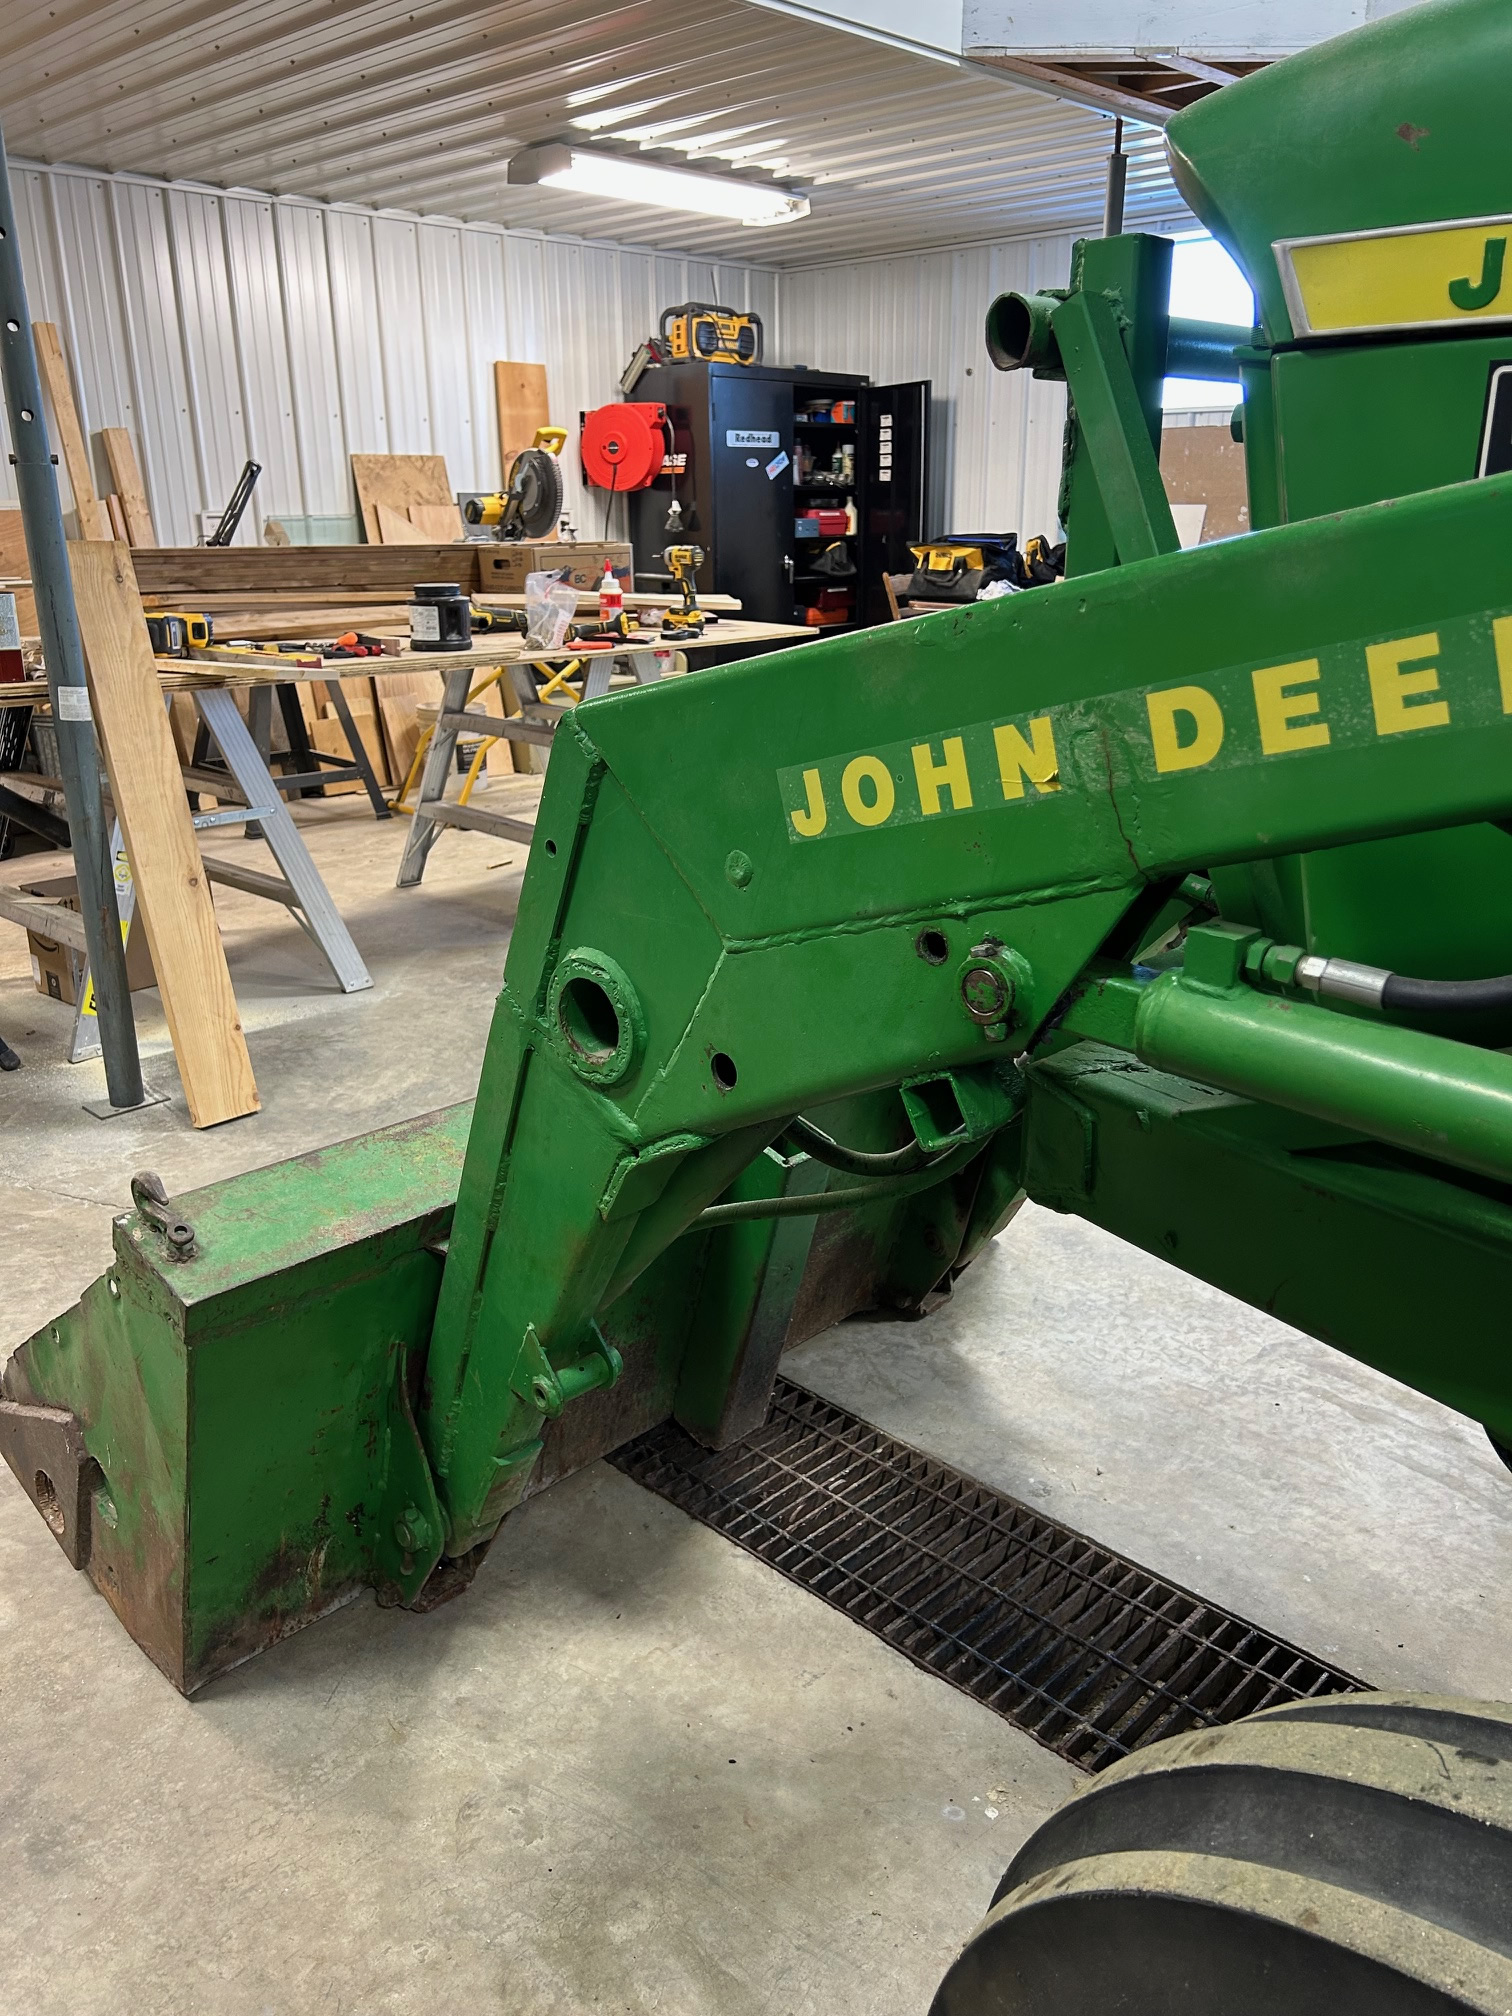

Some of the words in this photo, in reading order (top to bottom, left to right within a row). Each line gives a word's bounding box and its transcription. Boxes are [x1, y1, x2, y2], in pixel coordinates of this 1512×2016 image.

[735, 433, 772, 443] Redhead
[661, 453, 687, 466] ASE
[791, 716, 1062, 837] JOHN
